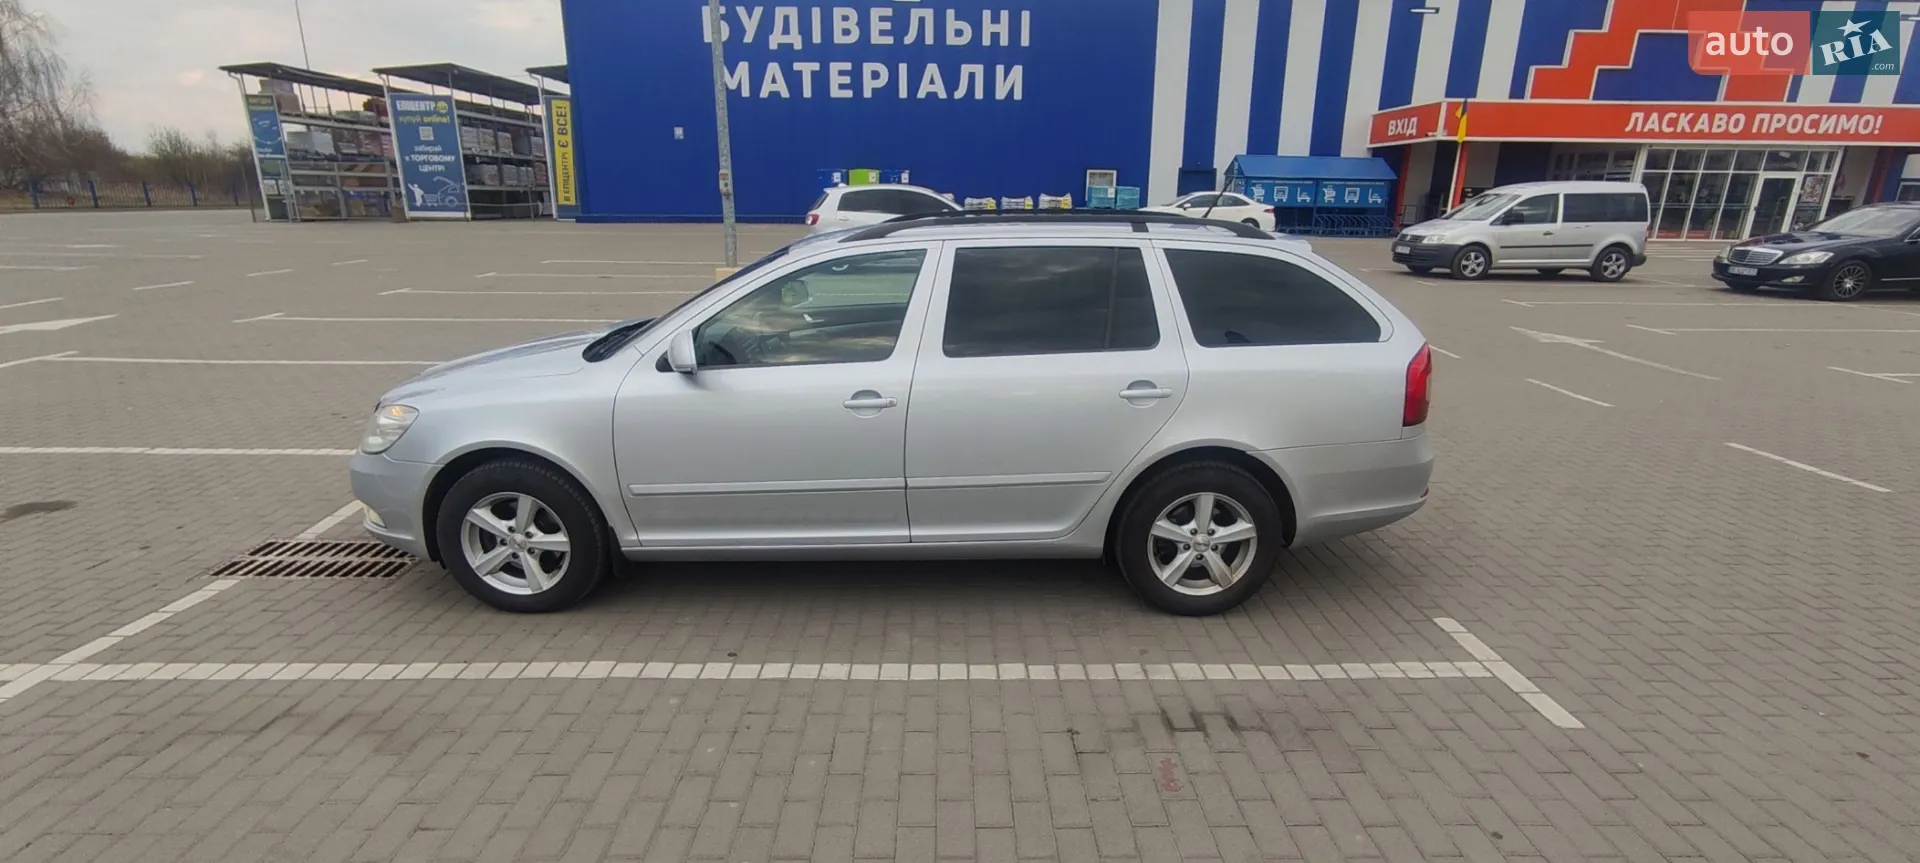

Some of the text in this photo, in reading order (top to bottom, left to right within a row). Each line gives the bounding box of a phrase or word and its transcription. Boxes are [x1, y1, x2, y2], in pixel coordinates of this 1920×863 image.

[702, 6, 1031, 50] БУДІВЕЛЬНІ
[722, 61, 1024, 101] МАТЕРІАЛИ
[556, 105, 569, 136] ВСЕ!
[1387, 116, 1418, 136] ВХІД
[1624, 111, 1884, 135] ЛАСКАВО ПРОСИМО!
